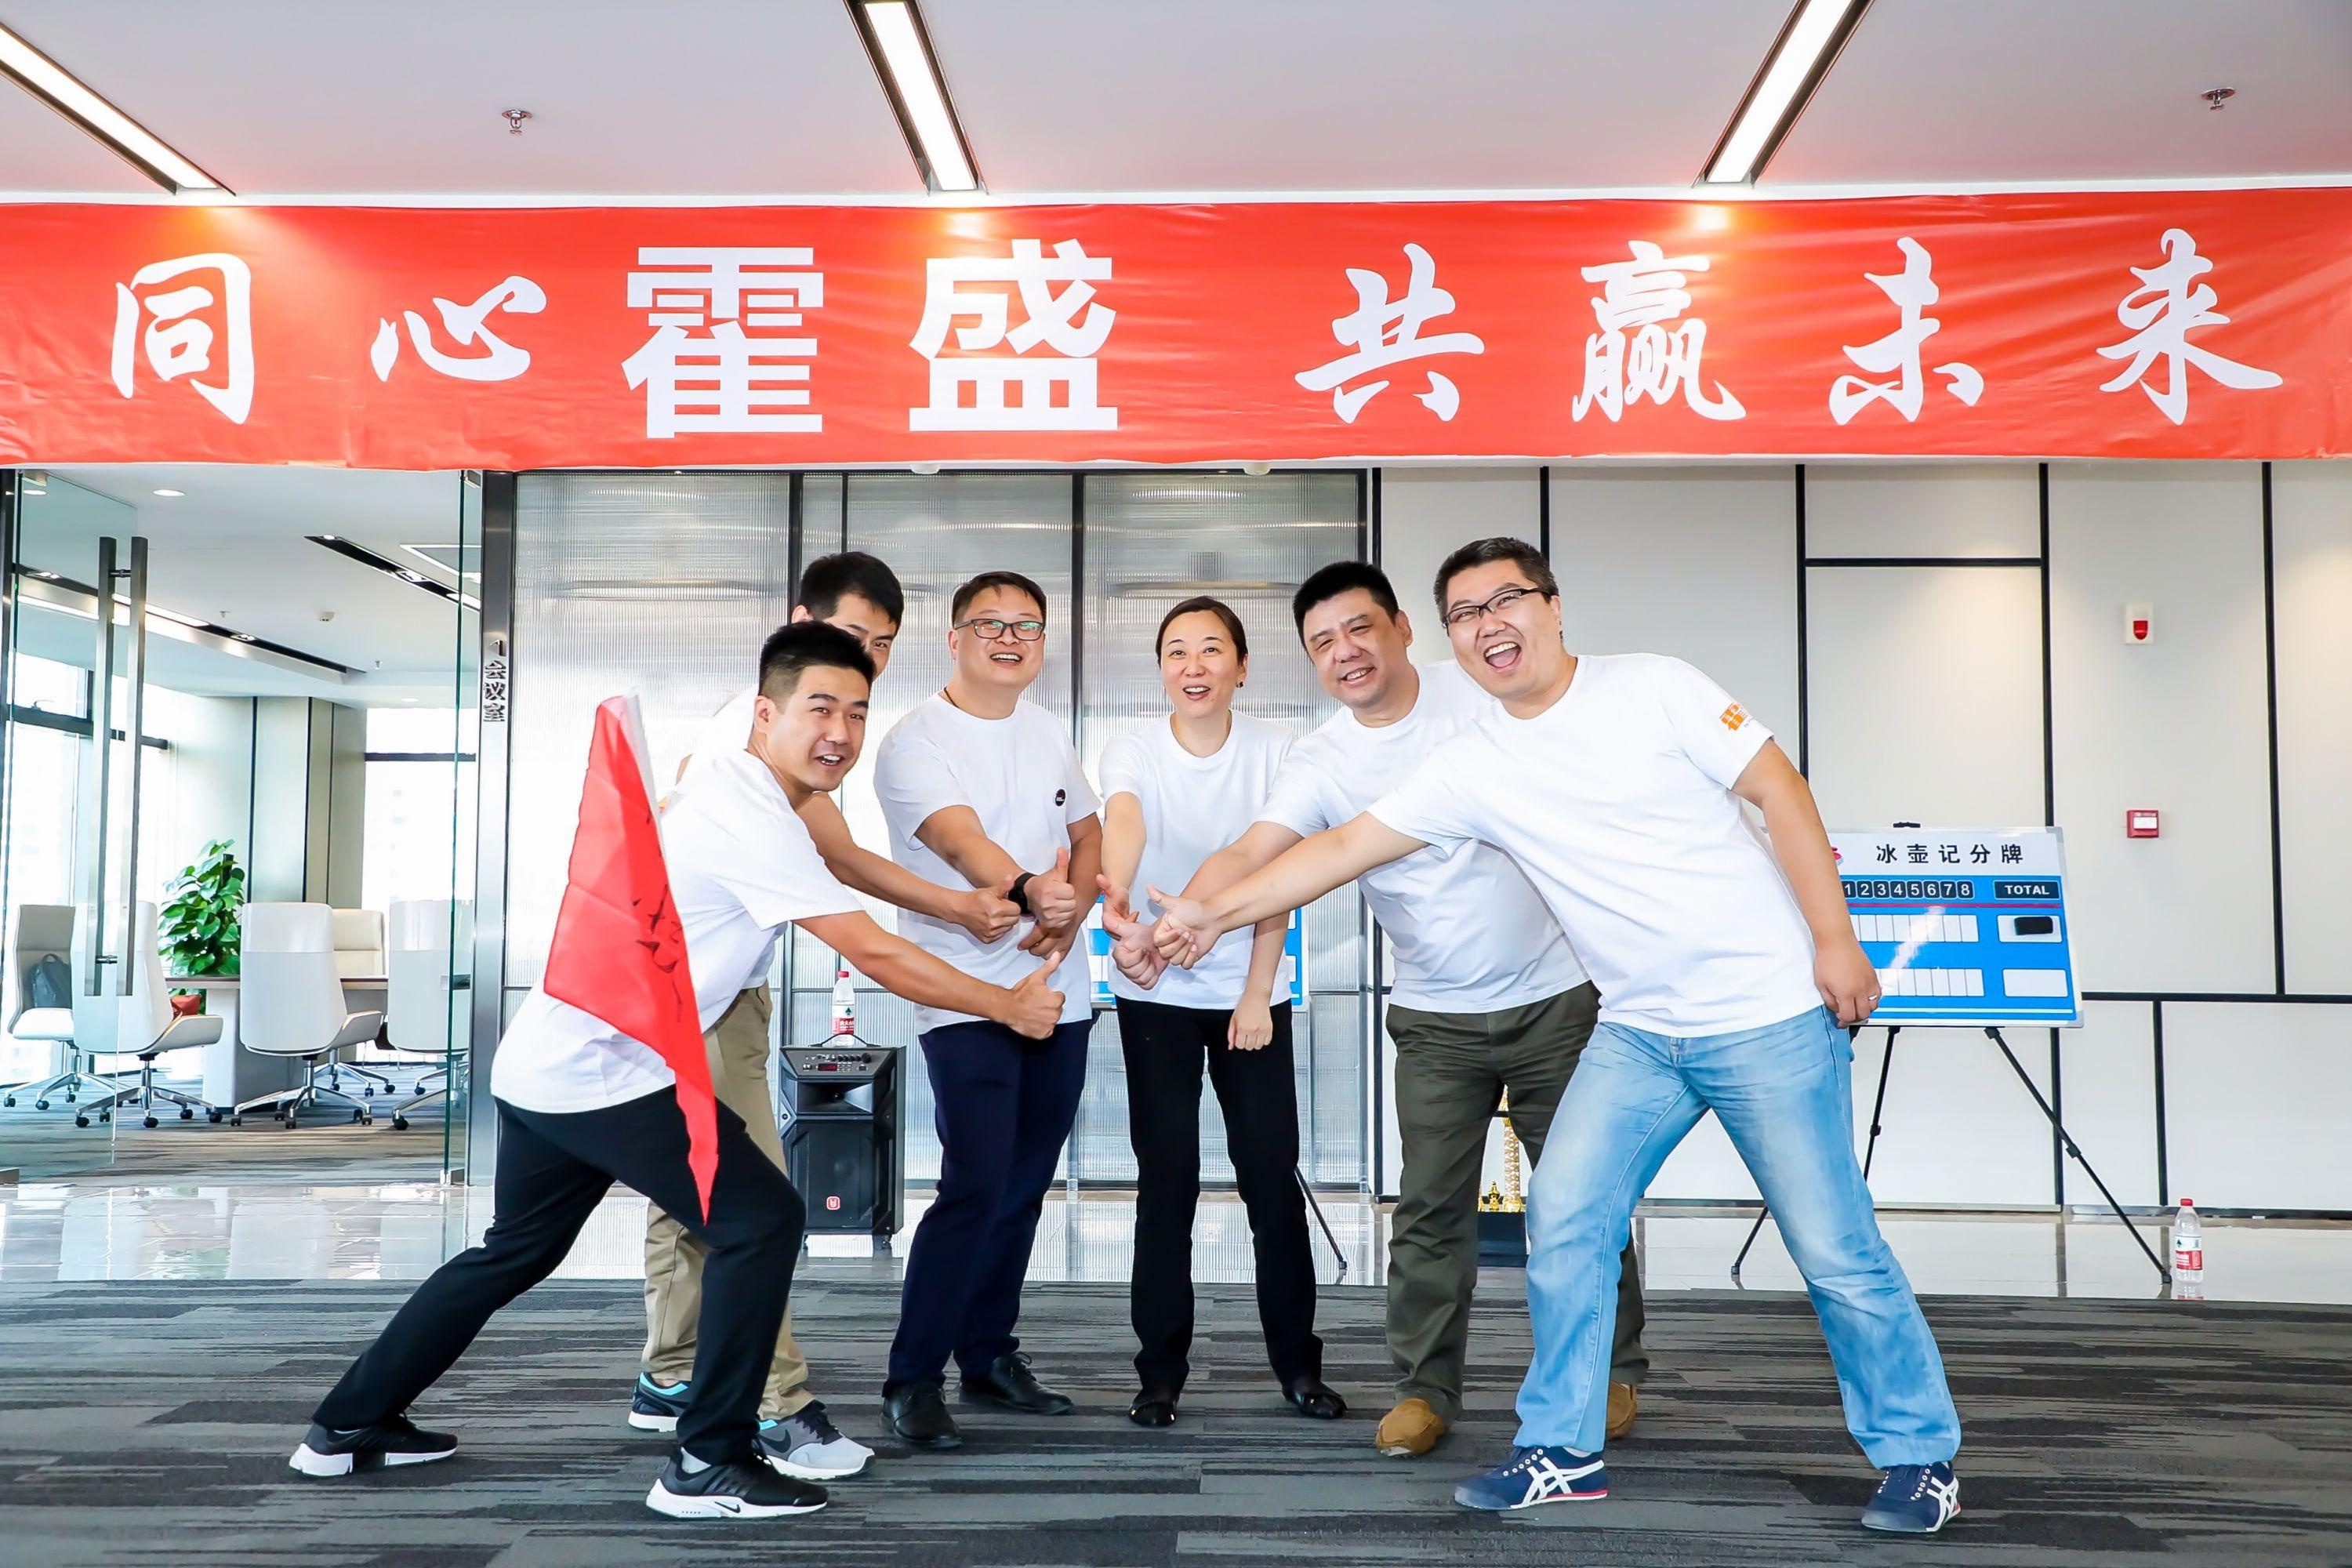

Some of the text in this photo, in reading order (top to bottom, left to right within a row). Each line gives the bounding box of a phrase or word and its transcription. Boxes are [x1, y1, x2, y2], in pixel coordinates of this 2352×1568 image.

[111, 228, 2283, 439] 同心霍盛 共赢未来
[1876, 844, 2024, 864] 冰壶记分牌
[2004, 885, 2050, 895] TOTAL
